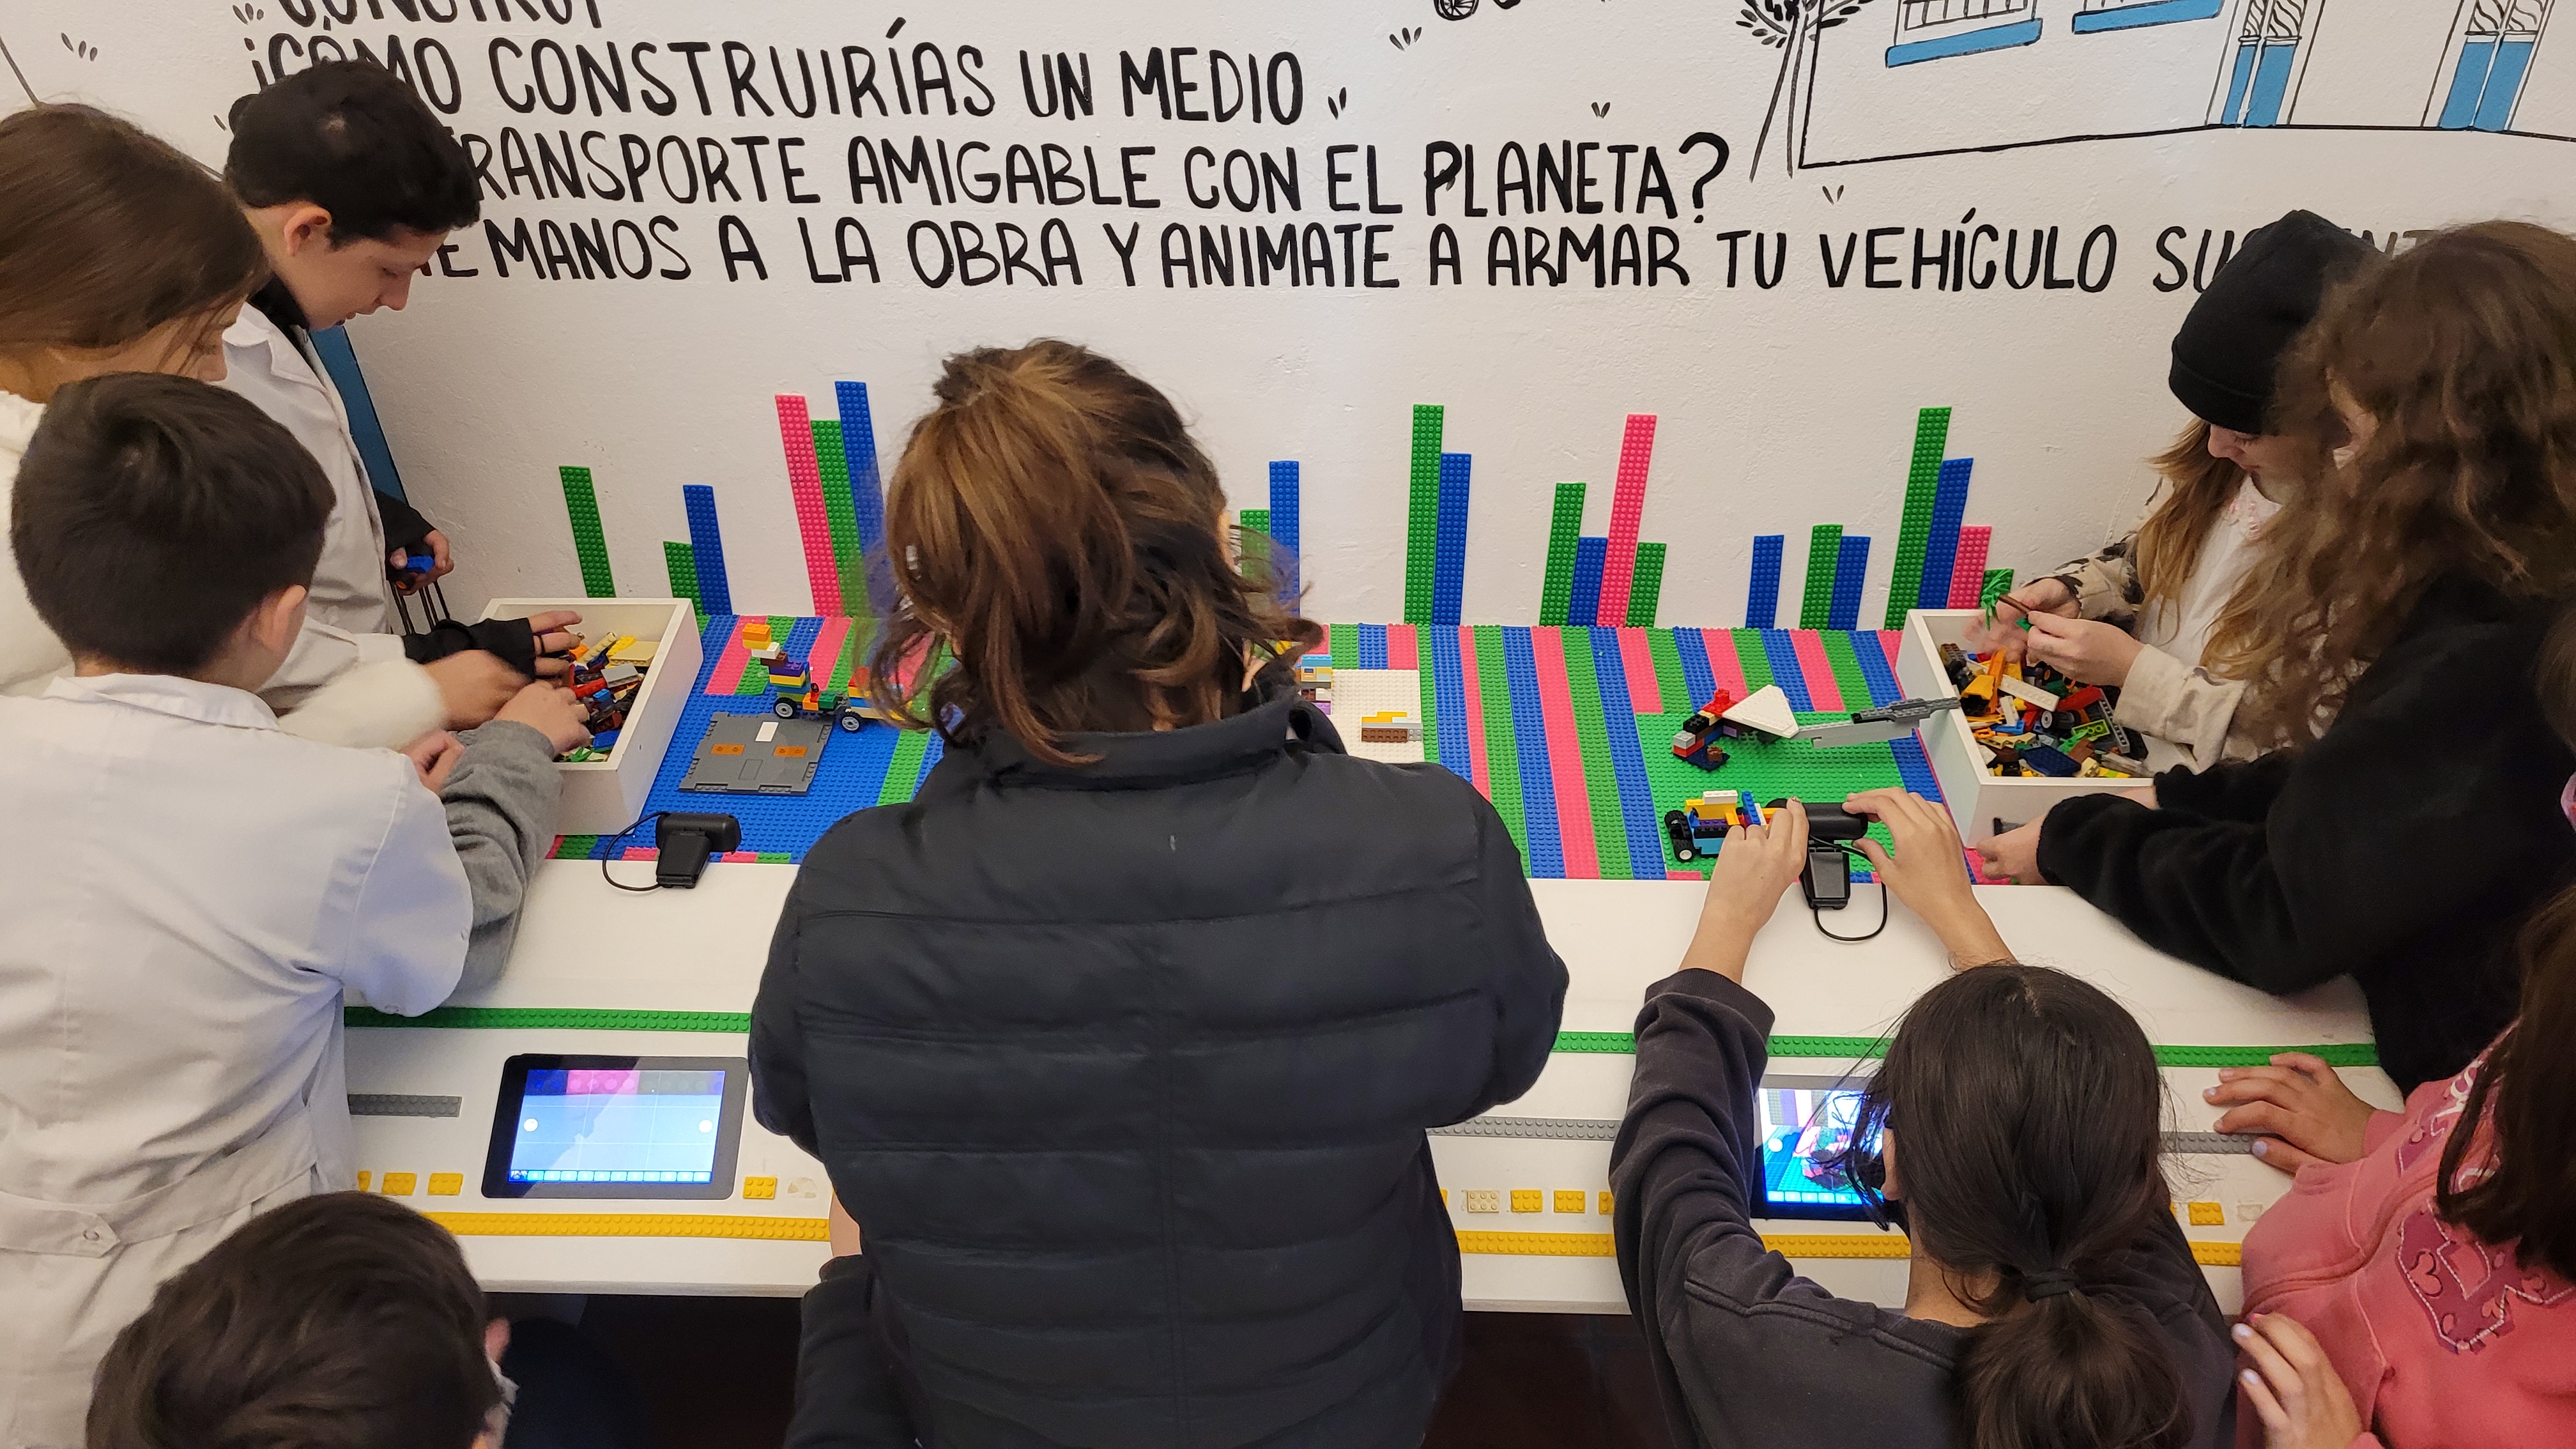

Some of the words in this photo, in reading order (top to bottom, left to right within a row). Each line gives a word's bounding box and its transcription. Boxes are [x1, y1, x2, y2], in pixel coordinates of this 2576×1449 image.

[489, 17, 995, 118] CONSTRUIRÍAS
[1020, 50, 1093, 120] UN
[1119, 47, 1303, 125] MEDIO
[443, 126, 820, 206] RANSPORTE
[848, 135, 1160, 209] AMIGABLE
[1184, 146, 1301, 213] CON
[1326, 144, 1402, 214] EL
[1424, 132, 1729, 223] PLANETA?
[483, 218, 691, 280] MANOS
[719, 215, 768, 282] A
[797, 217, 880, 283] LA
[907, 218, 1082, 288] OBRA
[1103, 222, 1139, 286] Y
[1161, 222, 1399, 288] ANIMATE
[1430, 224, 1462, 286] A
[1488, 224, 1690, 288] ARMAR
[1717, 230, 1786, 289] TU
[1820, 208, 2117, 293] VEHÍCULO
